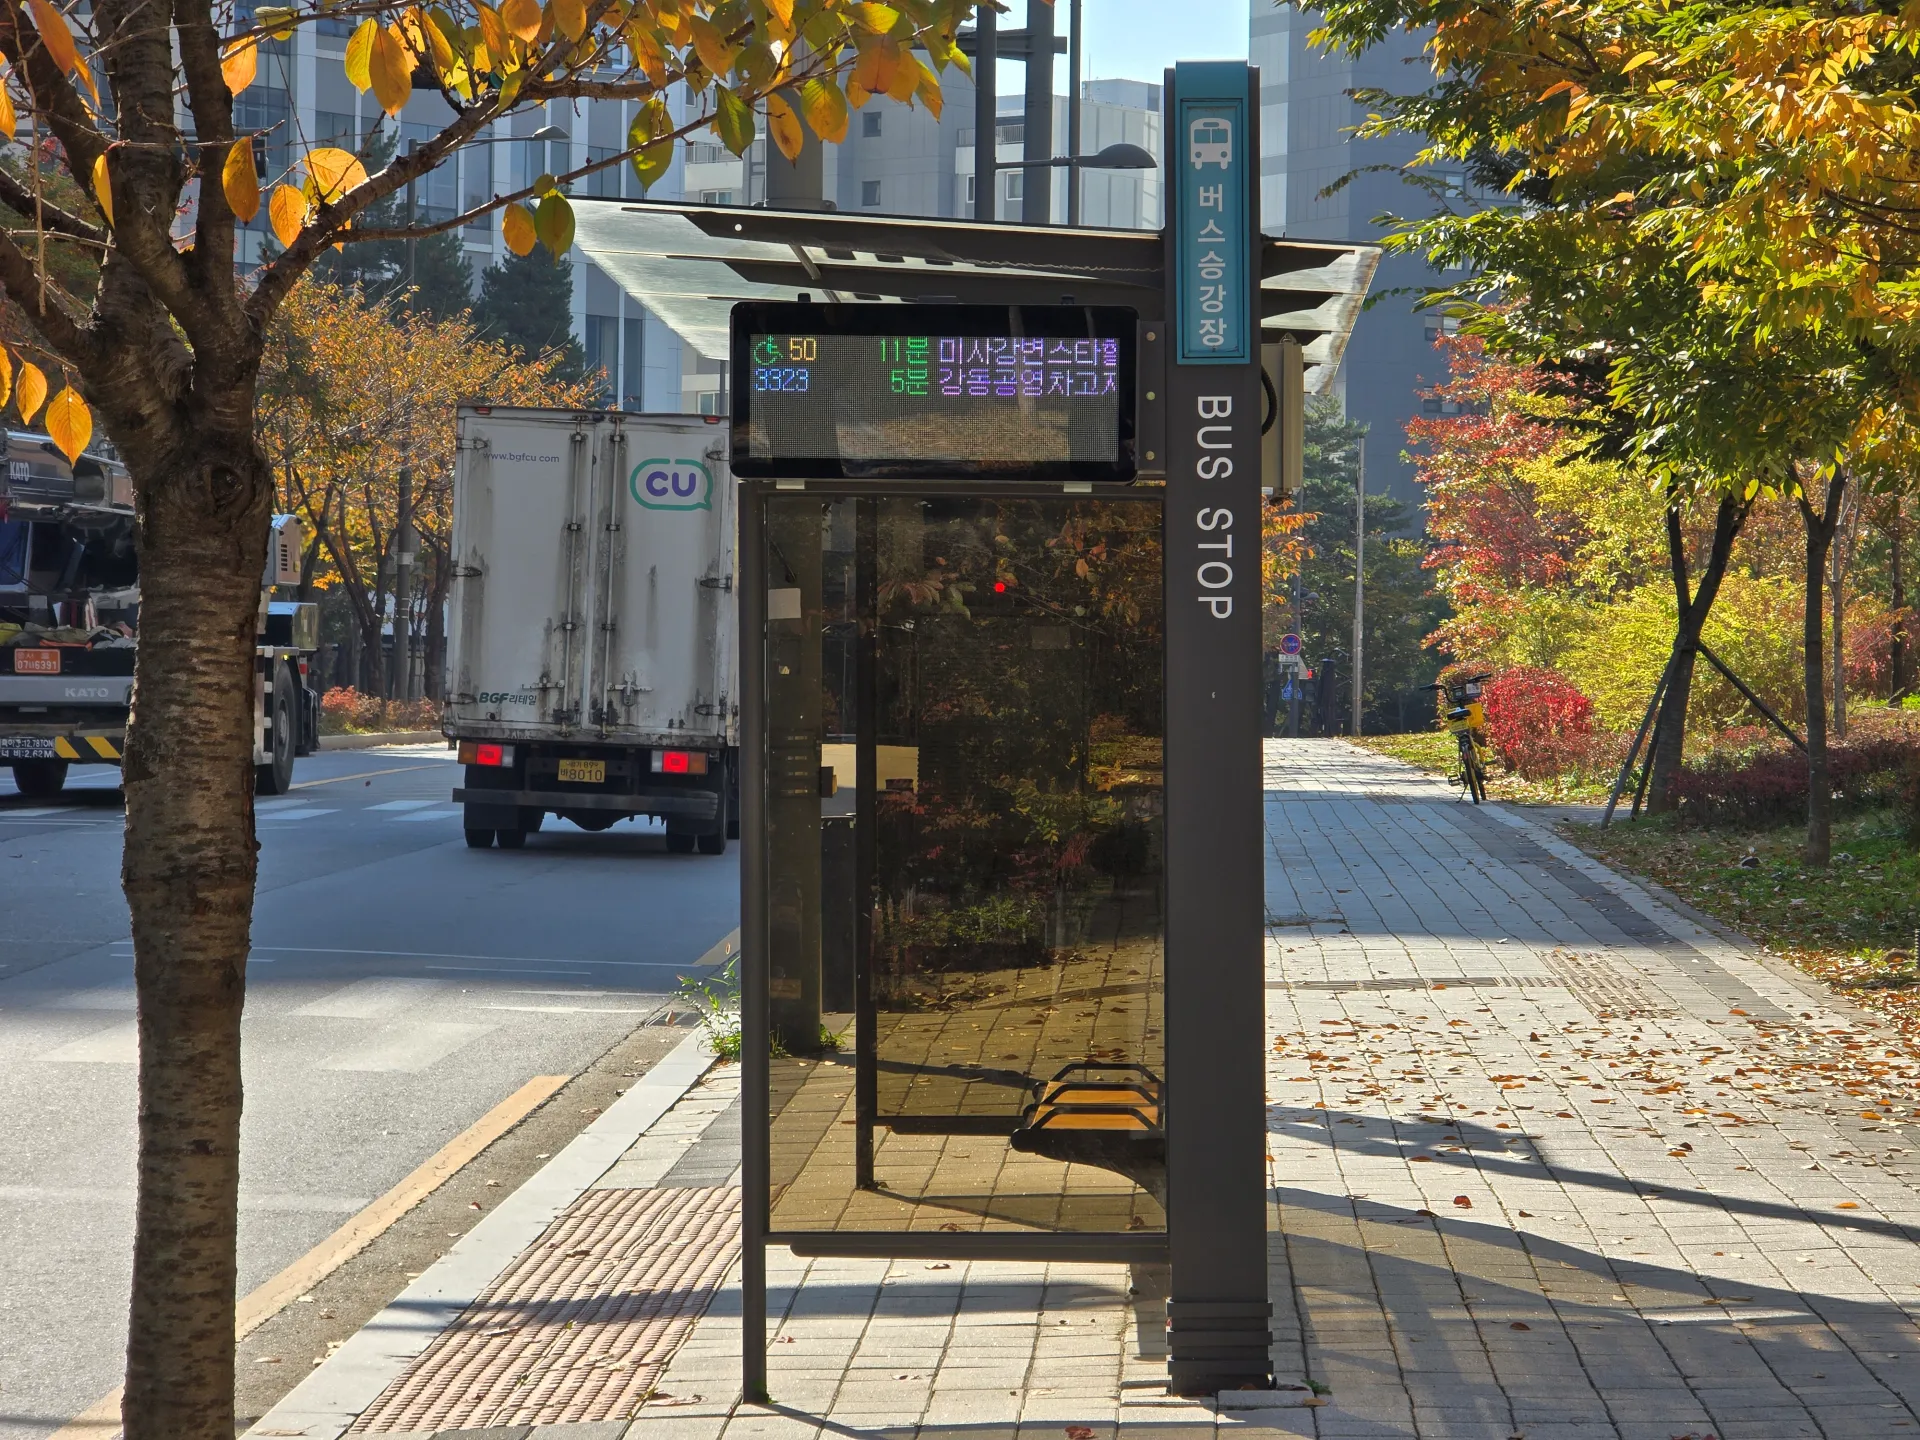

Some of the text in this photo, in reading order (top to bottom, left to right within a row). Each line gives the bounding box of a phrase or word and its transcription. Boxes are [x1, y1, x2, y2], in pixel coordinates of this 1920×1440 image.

[1197, 184, 1228, 348] 버스승강장
[789, 337, 817, 361] 50
[879, 336, 930, 364] 11분
[755, 368, 809, 392] 3323
[891, 367, 930, 395] 5분
[483, 452, 560, 463] www.bgfcucom
[9, 461, 30, 482] KATO
[645, 470, 697, 498] CU
[1196, 395, 1234, 619] BUS STOP
[64, 687, 109, 698] KATO
[479, 691, 537, 706] BGF리테일
